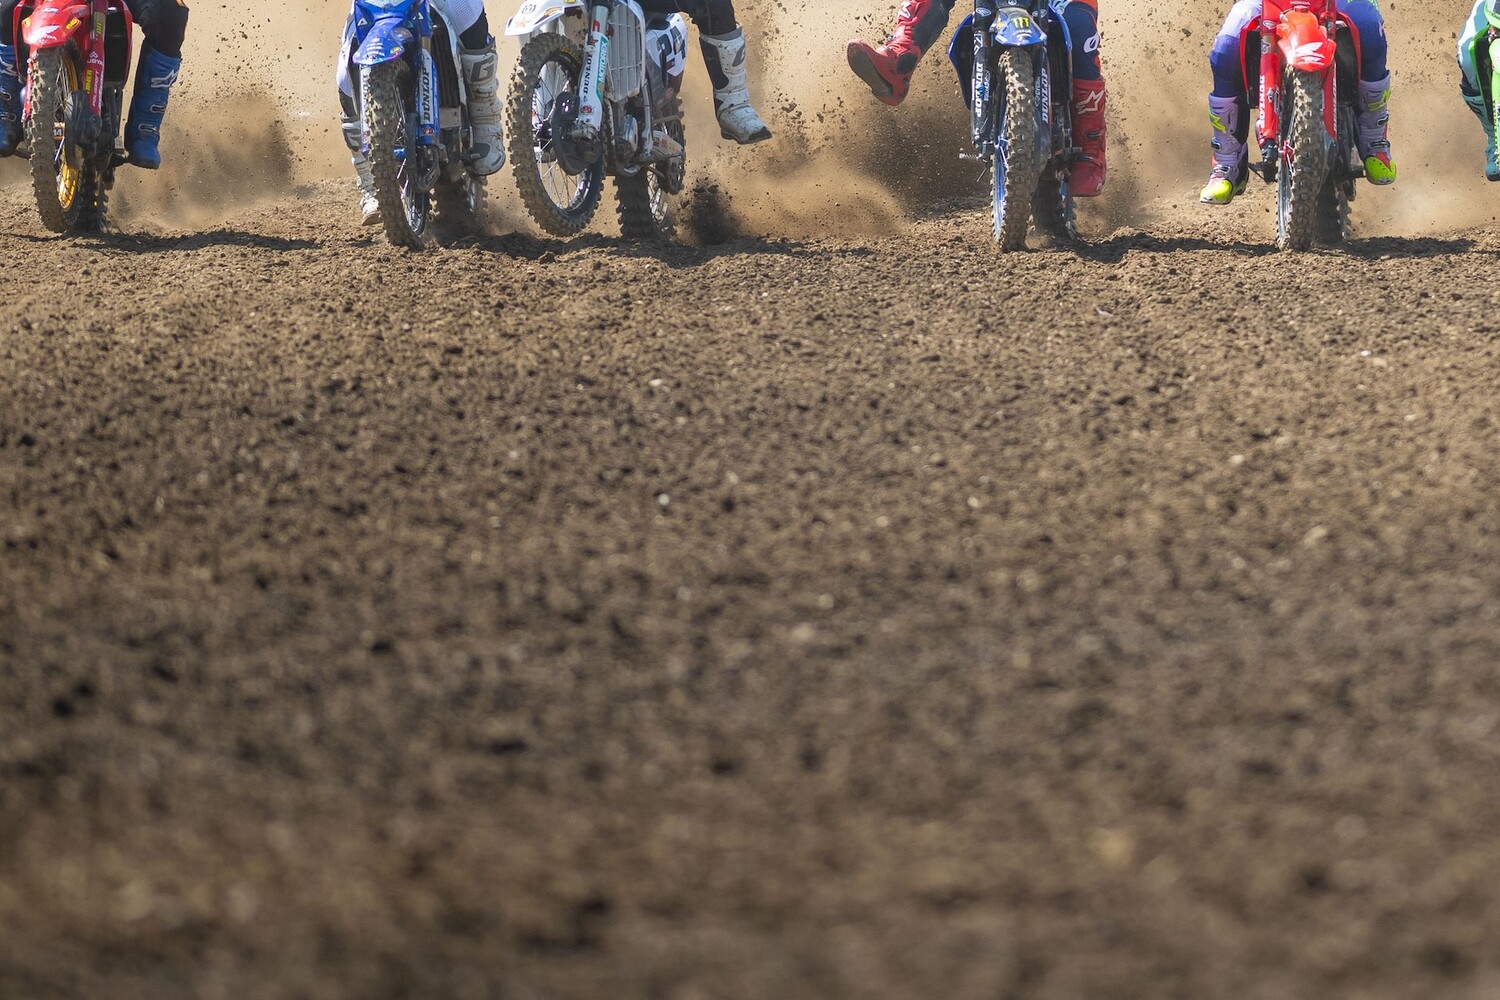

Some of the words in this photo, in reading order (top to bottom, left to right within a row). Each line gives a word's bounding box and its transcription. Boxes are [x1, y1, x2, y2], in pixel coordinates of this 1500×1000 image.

[421, 67, 430, 122] DUNLOP
[975, 61, 983, 118] DUNLOP
[1041, 68, 1049, 122] DUNLOP
